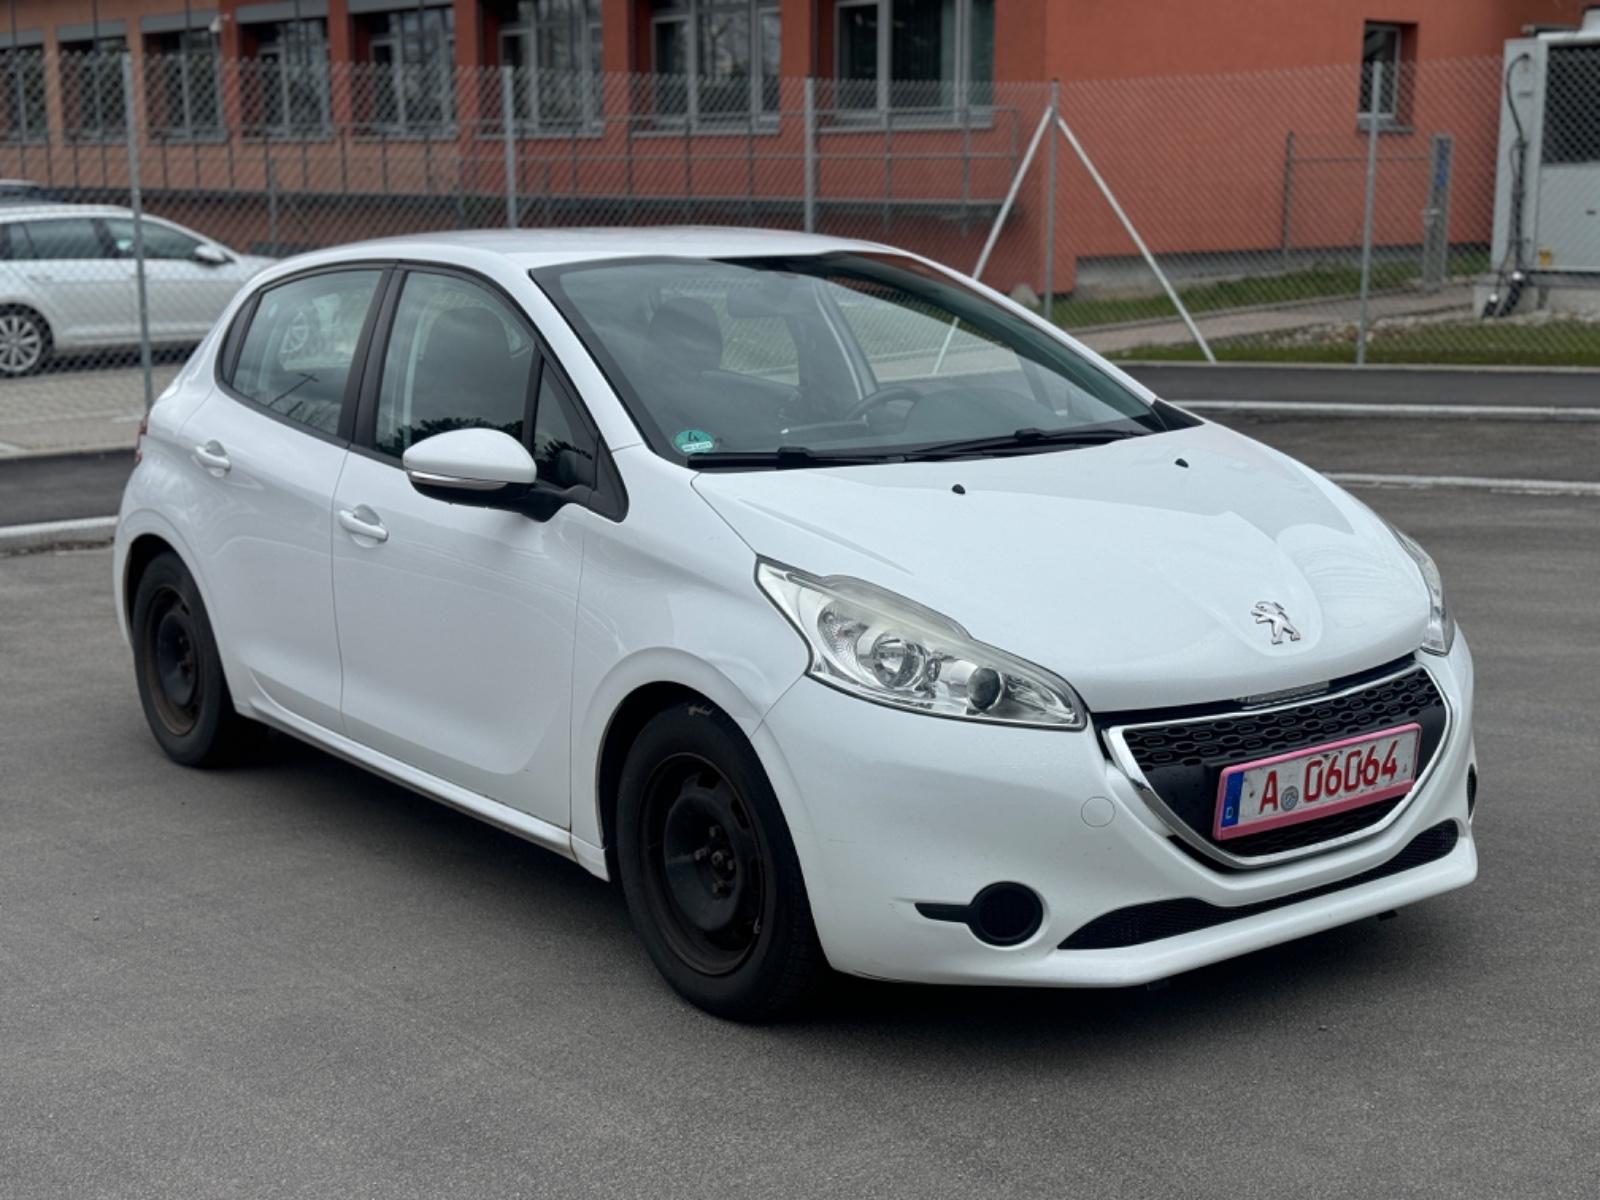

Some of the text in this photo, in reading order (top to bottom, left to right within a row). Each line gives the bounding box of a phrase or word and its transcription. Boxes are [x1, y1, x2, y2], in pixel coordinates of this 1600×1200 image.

[1259, 770, 1279, 814] A
[1304, 740, 1399, 803] 06064
[1225, 806, 1234, 819] D
